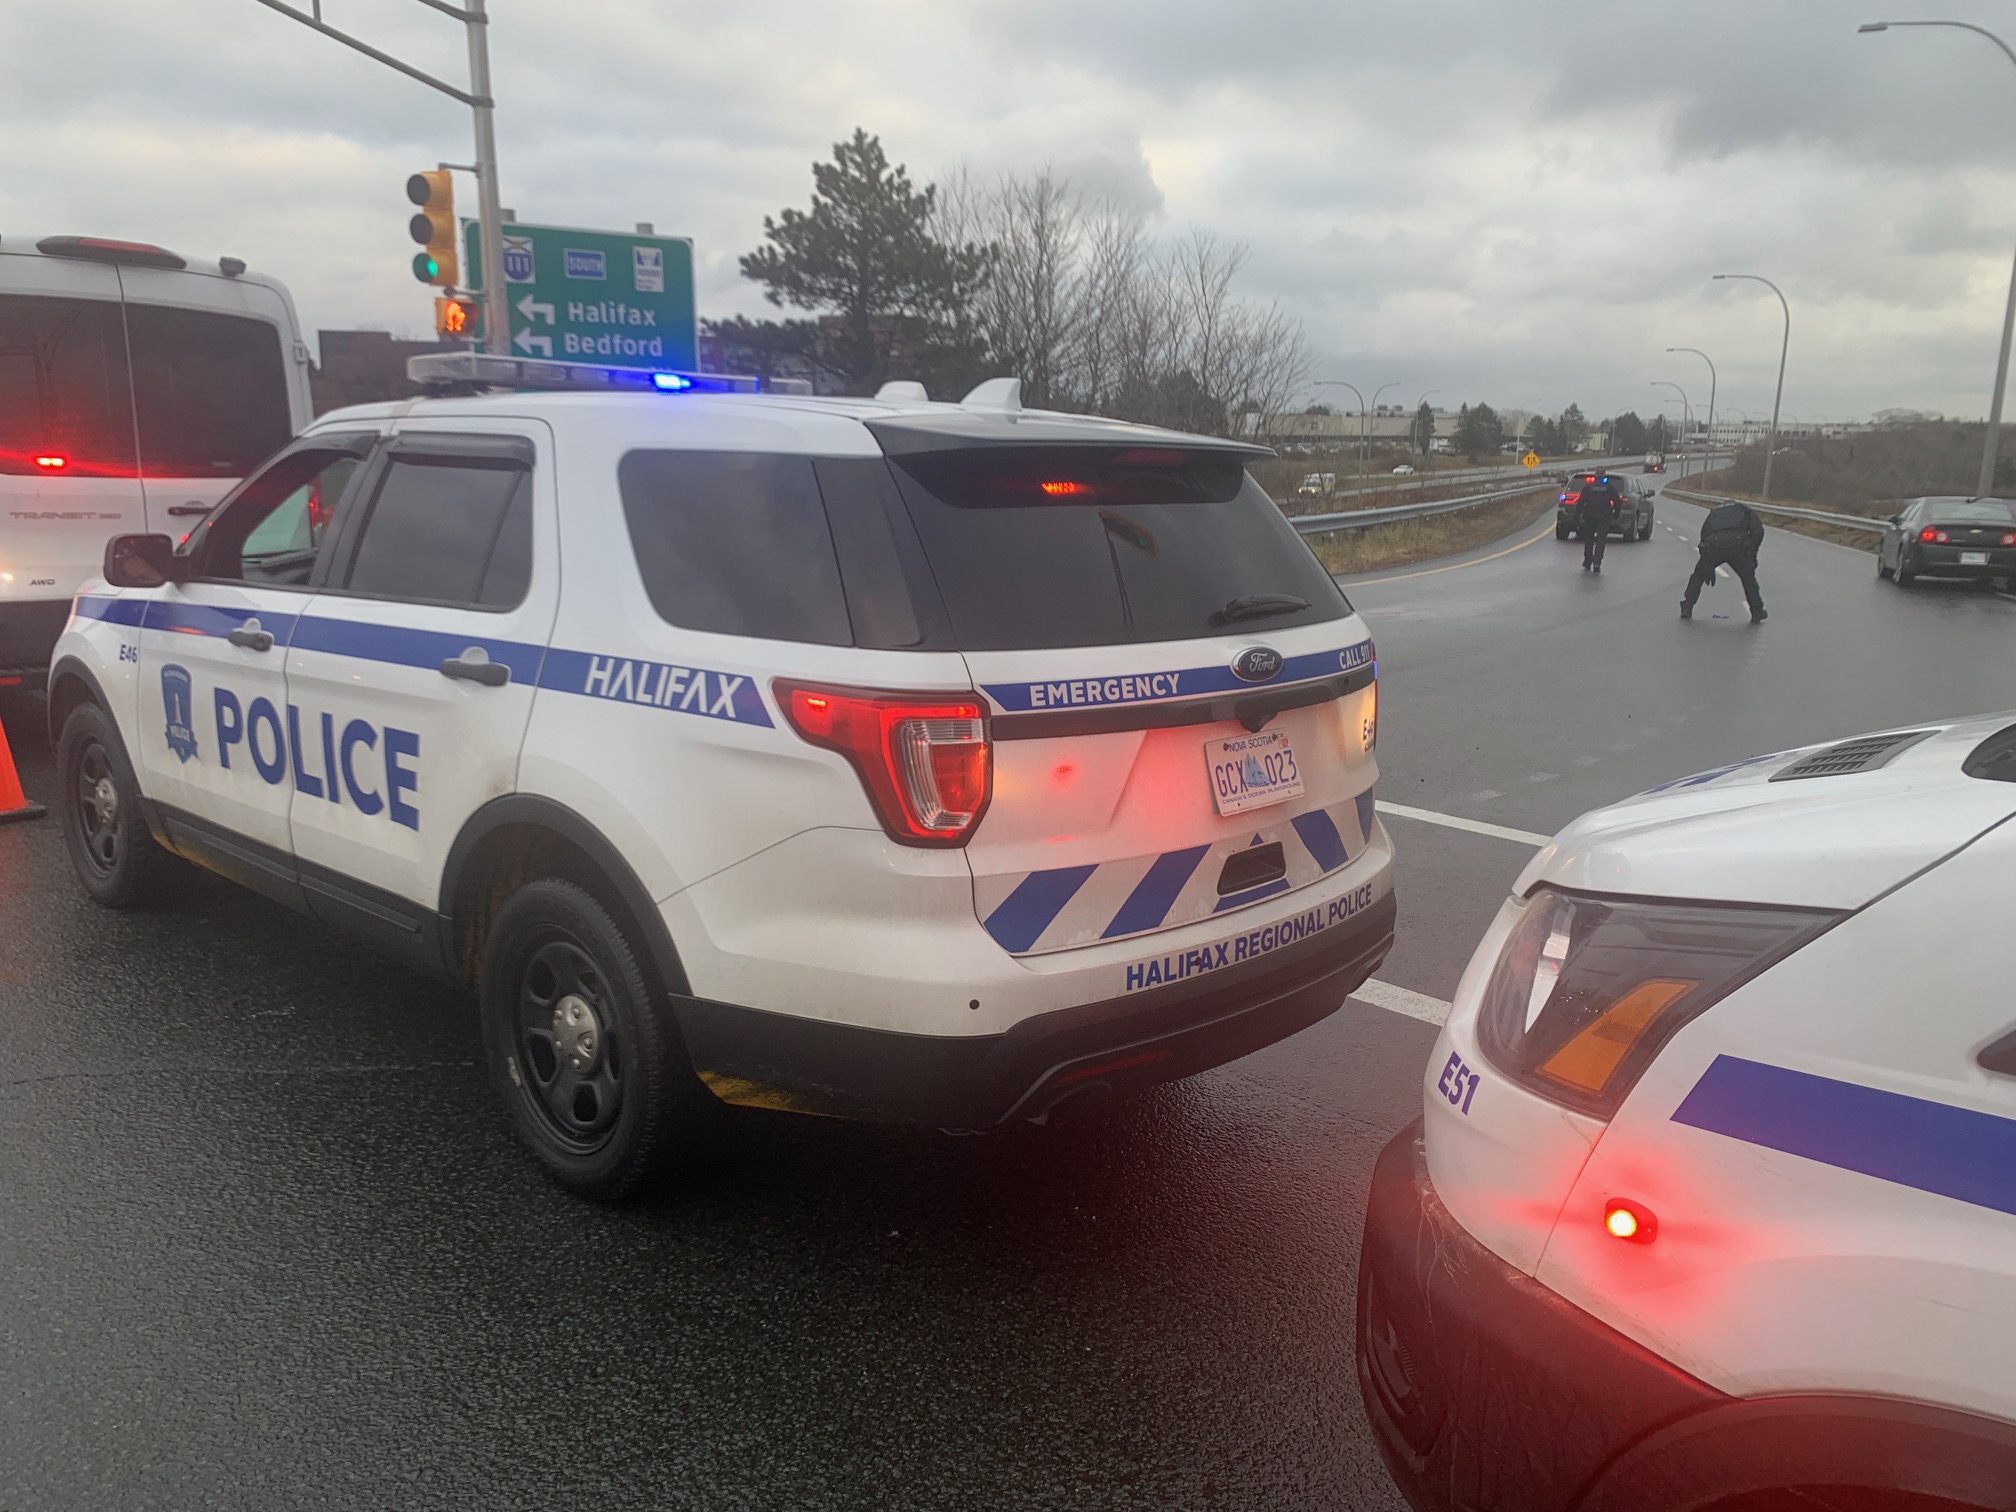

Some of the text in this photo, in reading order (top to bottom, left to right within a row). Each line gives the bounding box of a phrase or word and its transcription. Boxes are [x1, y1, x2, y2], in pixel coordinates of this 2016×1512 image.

[567, 301, 657, 327] Halifax
[564, 332, 663, 357] Bedford
[10, 511, 96, 520] TRANSIT
[29, 578, 56, 586] AWD
[119, 643, 138, 664] E46
[1250, 652, 1276, 673] Ford
[584, 655, 744, 719] HALIFAX
[1029, 644, 1371, 707] EMERGENCY CALL 911
[1228, 735, 1273, 752] NOVA SCOTIA
[214, 686, 420, 832] POLICE
[1215, 749, 1297, 797] GCX 023
[1222, 781, 1301, 804] CANADA'S OCEAN PLAYGROUND
[1126, 882, 1372, 991] HALIFAX REGIONAL POLICE
[1437, 1050, 1481, 1116] E51
